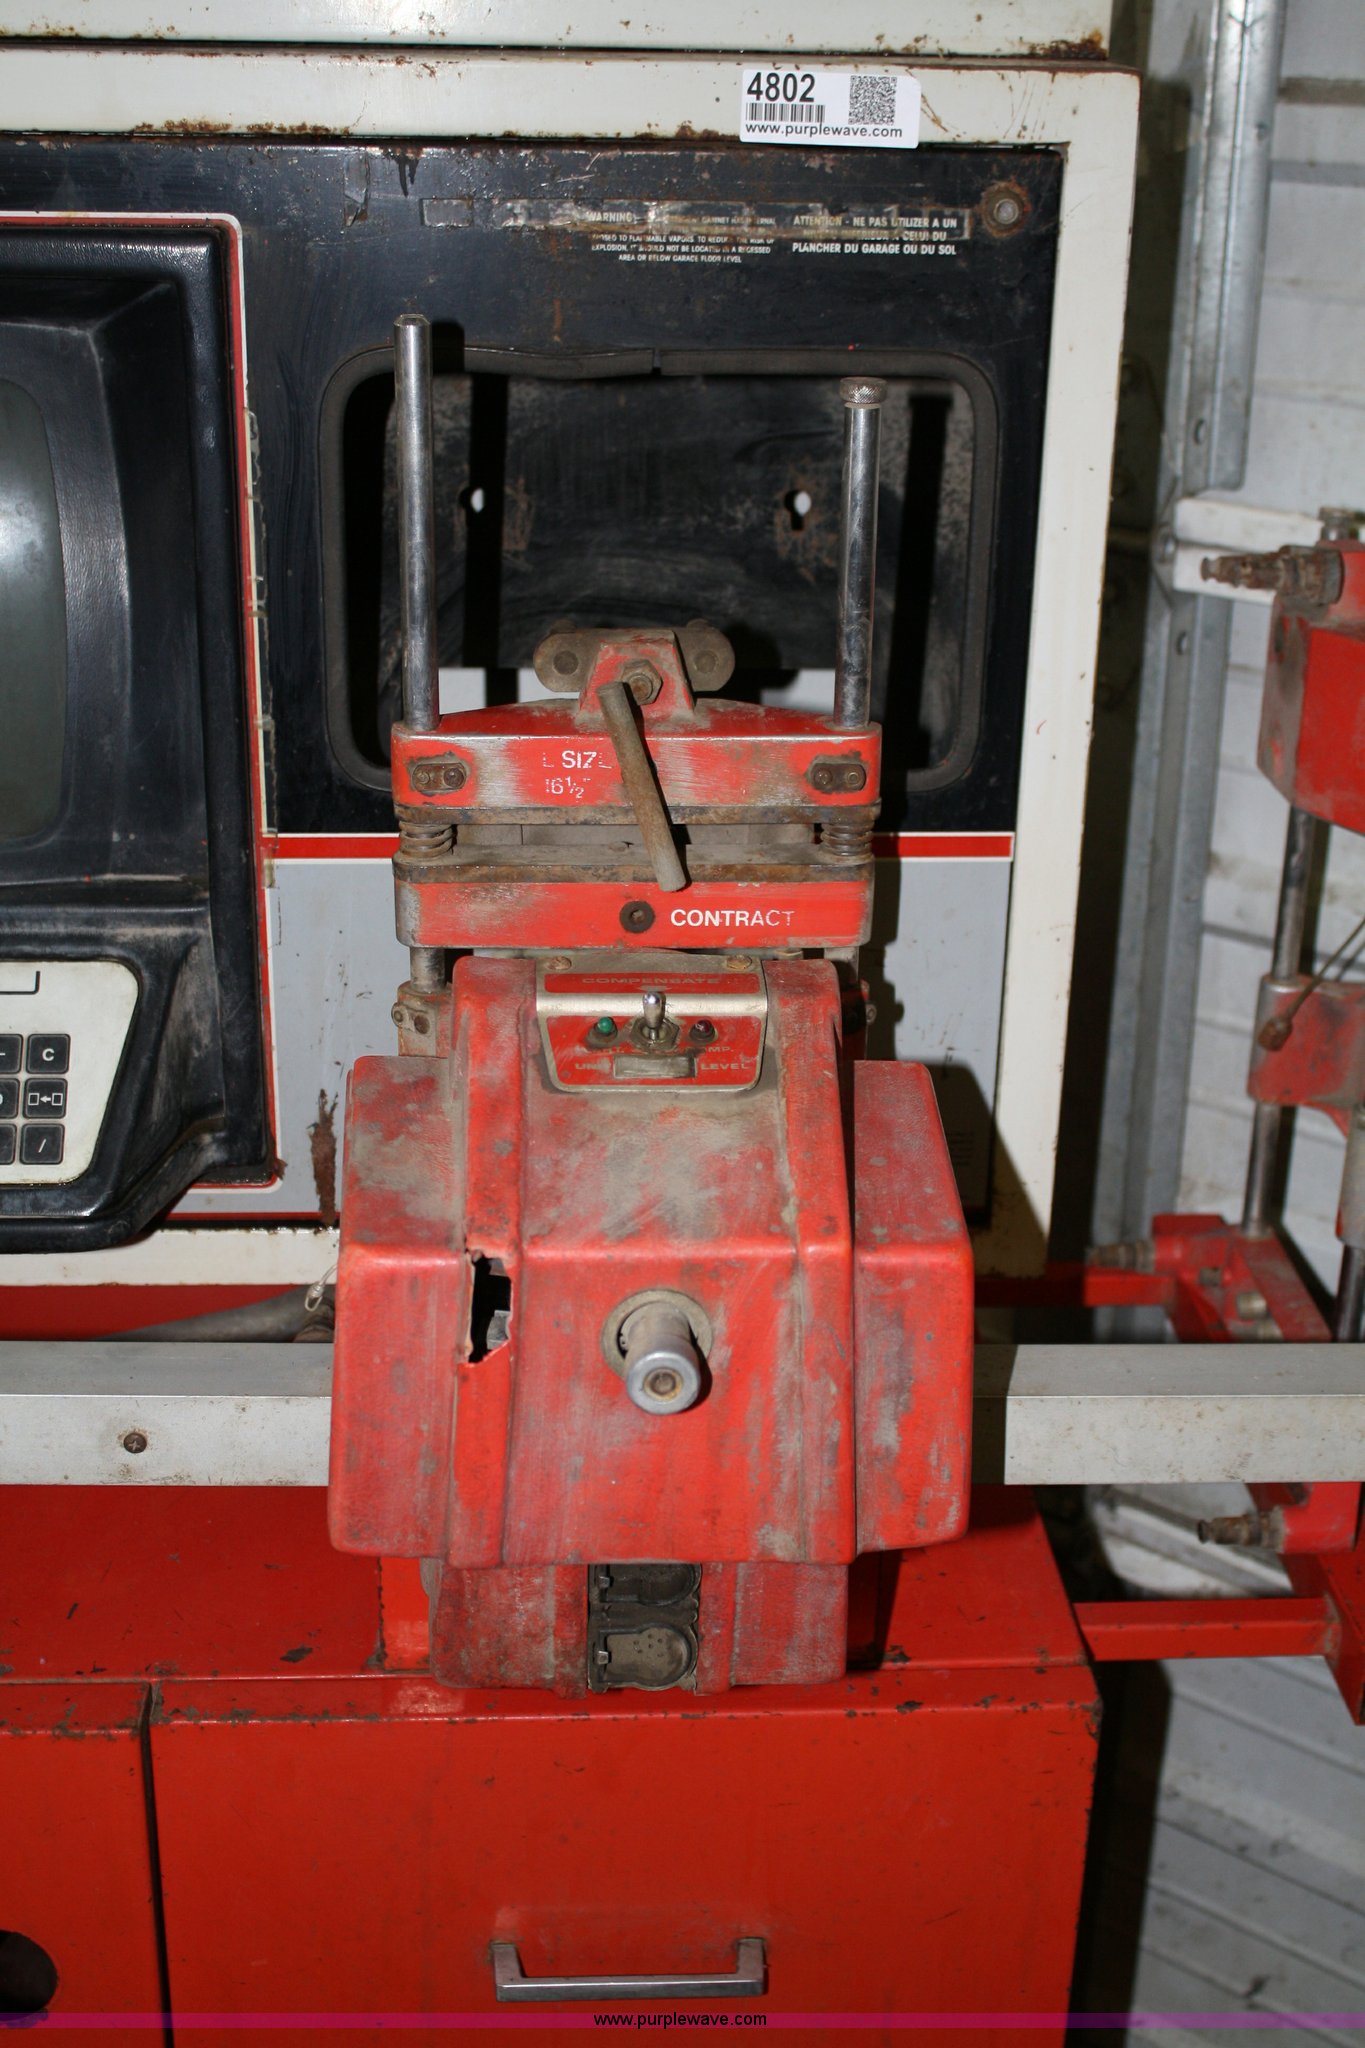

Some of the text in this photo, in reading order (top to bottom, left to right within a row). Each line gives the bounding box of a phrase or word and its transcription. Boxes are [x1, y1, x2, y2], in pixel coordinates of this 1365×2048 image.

[746, 71, 816, 103] 4802
[745, 122, 903, 138] www.purplewave.com
[793, 215, 843, 227] ATTENTION
[853, 216, 865, 227] NE
[868, 216, 887, 228] PAS
[890, 217, 930, 228] UTILIZER
[943, 218, 957, 228] UN
[932, 231, 947, 242] DU
[792, 242, 957, 256] PLANCHER DU GARAGE OU DU SOL
[618, 254, 636, 262] AREA
[637, 254, 647, 262] OR
[672, 254, 698, 263] GARAGE
[700, 255, 721, 263] FLOOR
[722, 255, 743, 263] LEVEL
[670, 909, 795, 927] CONTRACT
[581, 977, 721, 985] COMPENSATE
[42, 1048, 55, 1062] C
[701, 1063, 749, 1071] LEVEL
